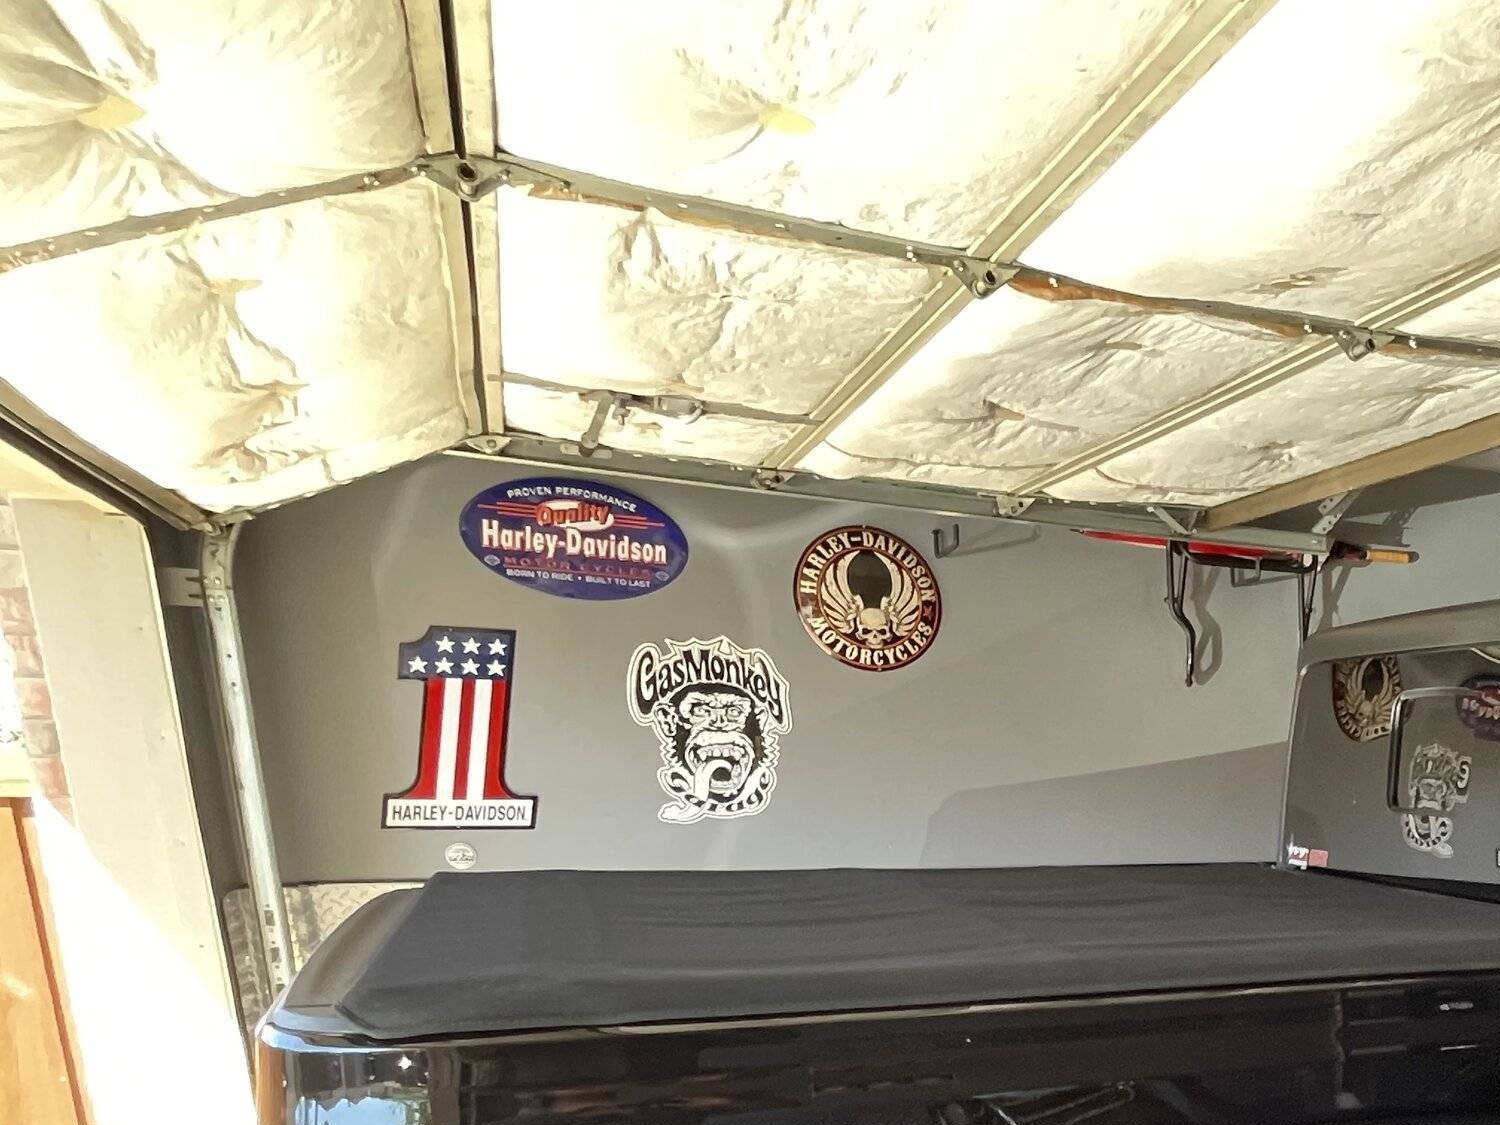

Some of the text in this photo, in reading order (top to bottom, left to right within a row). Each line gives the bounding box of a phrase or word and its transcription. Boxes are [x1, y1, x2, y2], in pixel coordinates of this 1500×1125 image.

[507, 486, 638, 513] PROVEN PERFORMANCE
[535, 501, 609, 526] Quality
[481, 518, 667, 564] Harley-Davidson
[506, 568, 651, 588] BORN TO RIDE BUILT TO LAST
[800, 531, 937, 603] HARLEY-DAVIDSON
[807, 617, 933, 666] MOTORCYCLES
[392, 804, 526, 821] HARLEY-DAVIDSON
